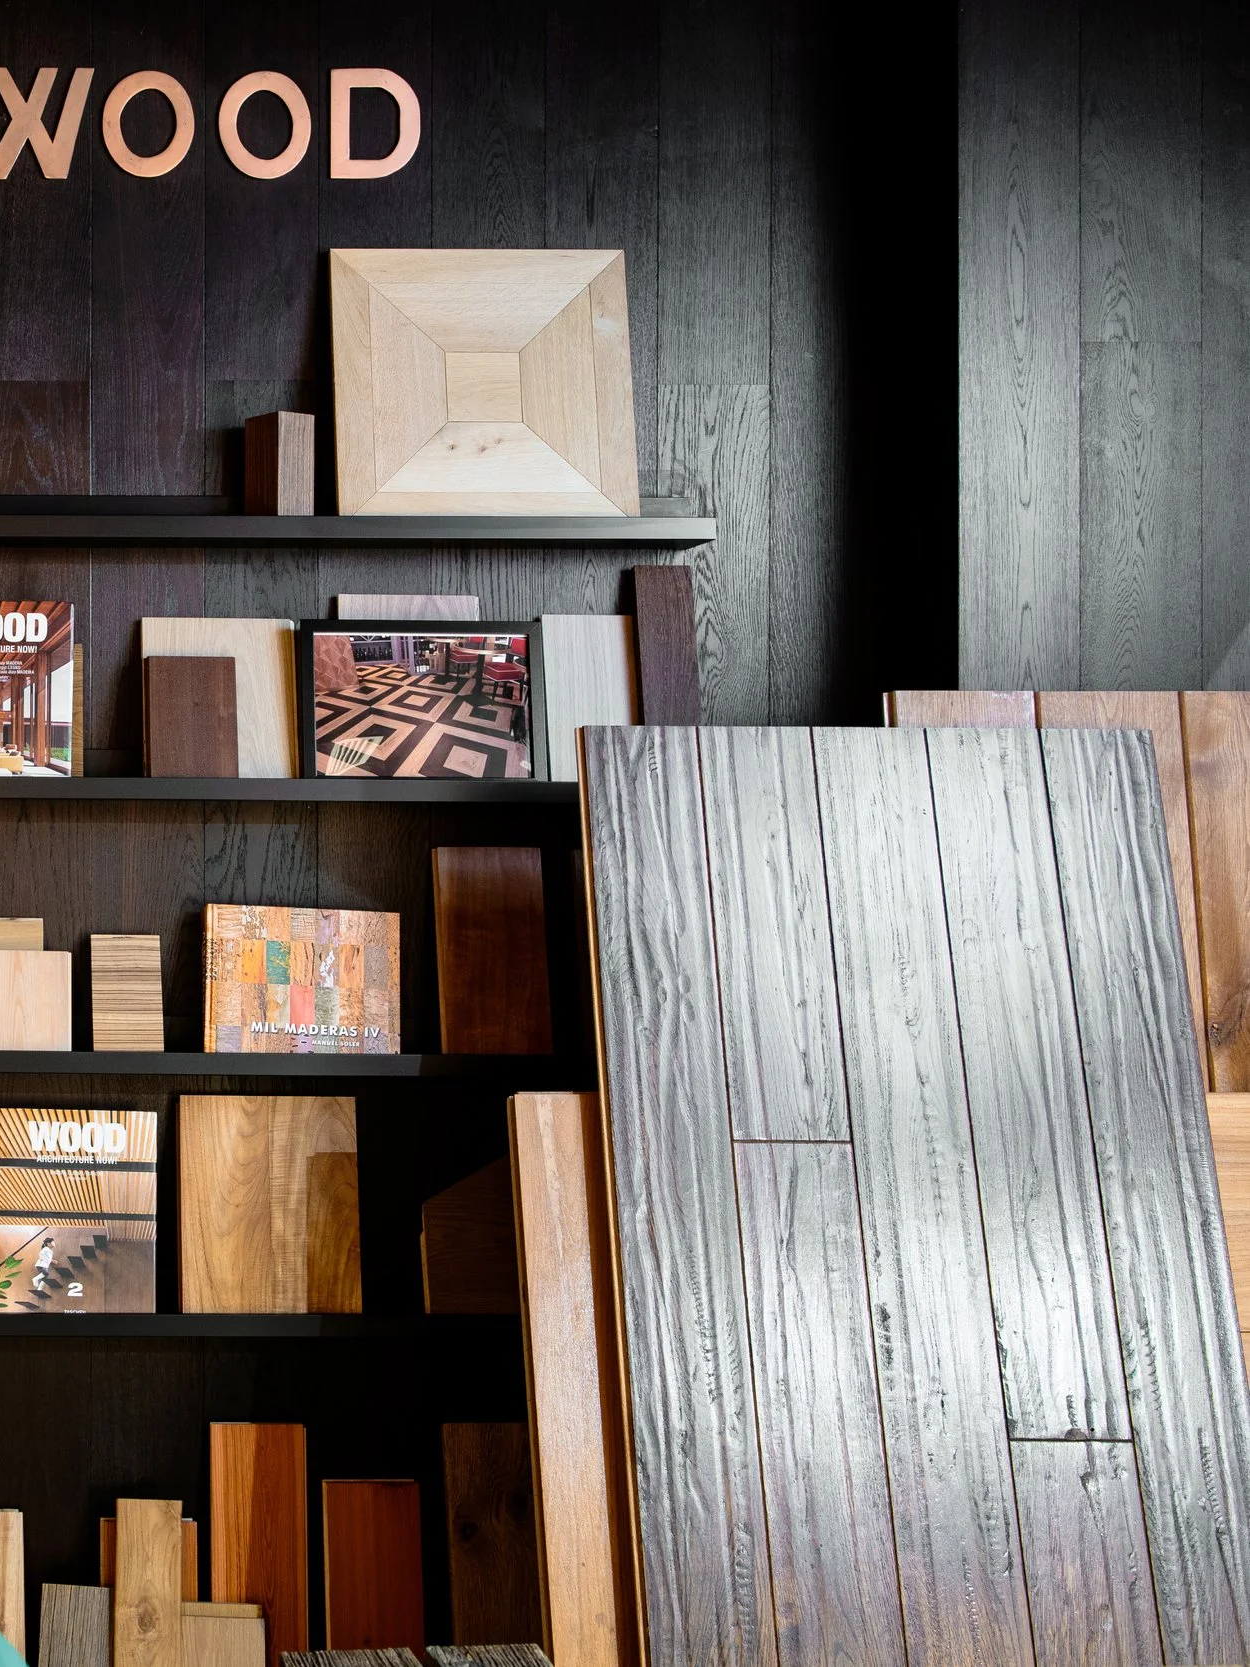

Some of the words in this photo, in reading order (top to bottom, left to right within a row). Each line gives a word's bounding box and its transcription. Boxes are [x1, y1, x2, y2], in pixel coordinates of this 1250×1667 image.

[17, 645, 38, 653] NOW!
[250, 1021, 279, 1033] MIL
[284, 1023, 358, 1037] MADERAS
[364, 1027, 381, 1038] IV
[28, 1120, 127, 1153] WOOD
[36, 1154, 95, 1164] ARCHITECTURE
[96, 1156, 118, 1165] NOW!
[67, 1282, 83, 1297] 2
